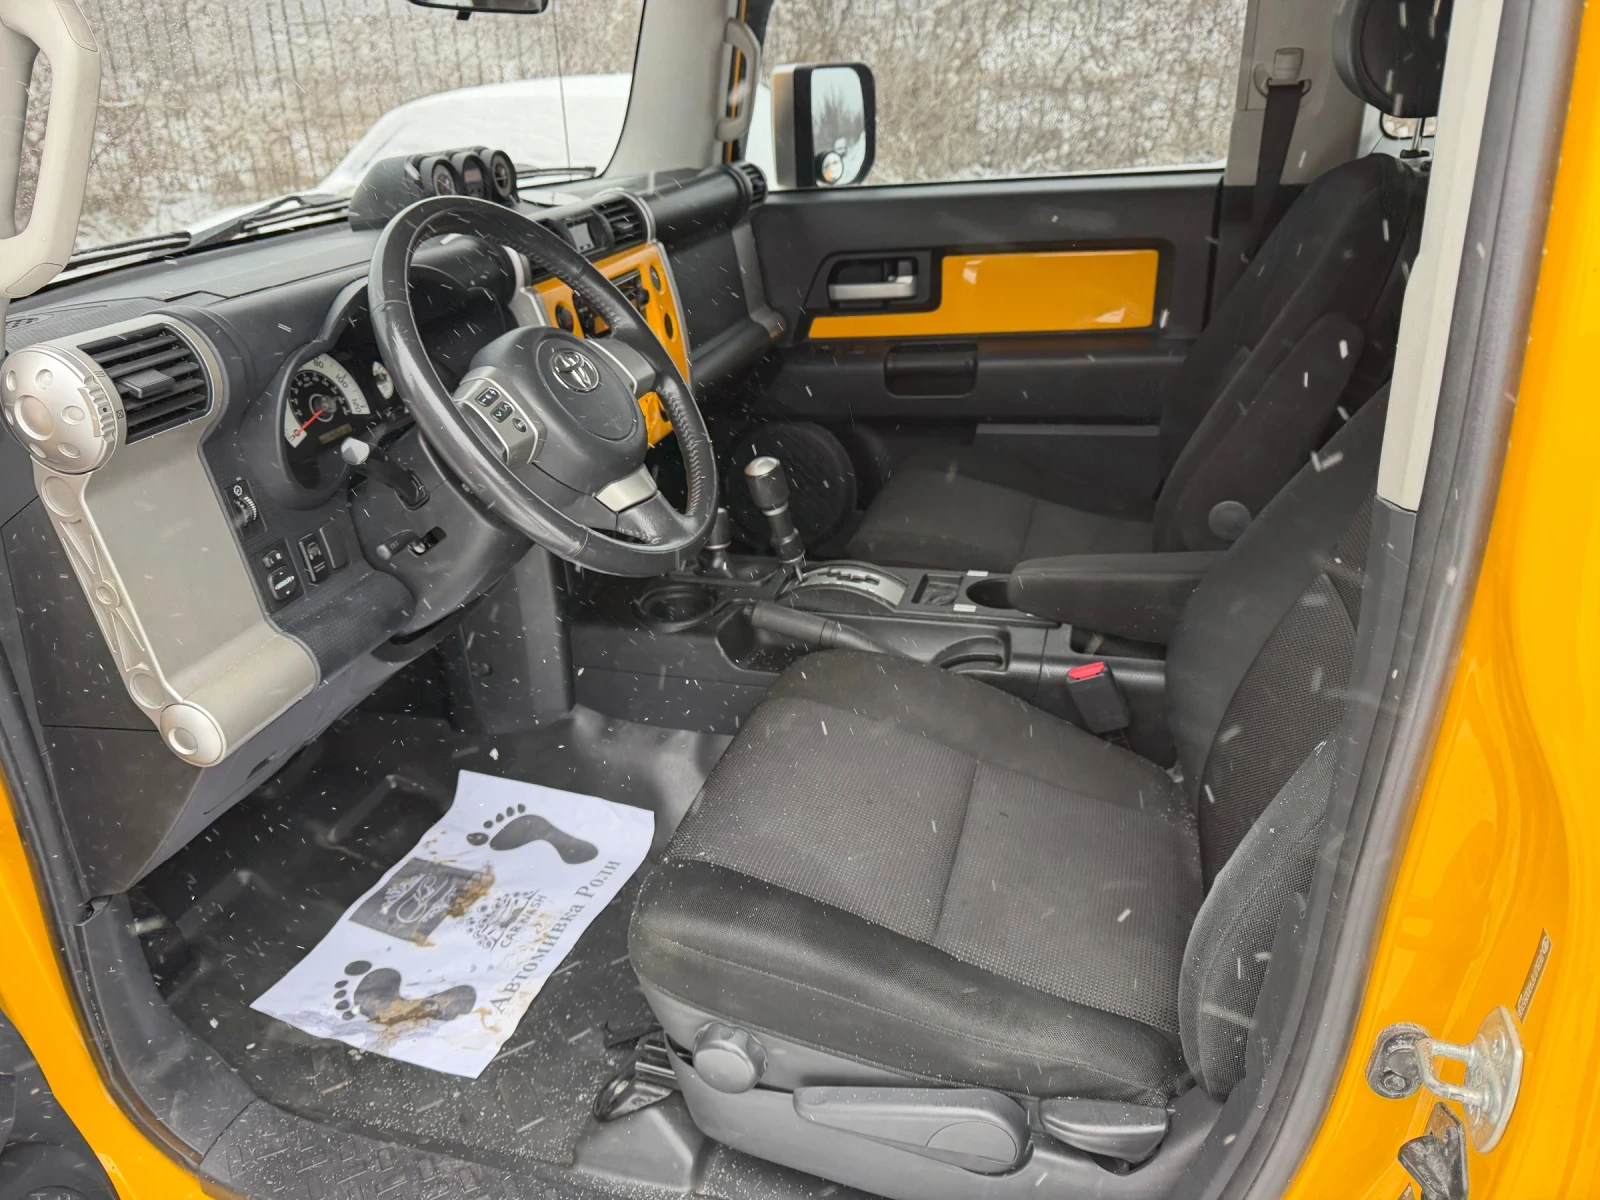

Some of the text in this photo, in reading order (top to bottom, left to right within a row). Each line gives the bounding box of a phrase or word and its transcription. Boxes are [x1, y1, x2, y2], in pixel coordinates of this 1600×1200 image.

[335, 374, 349, 389] 100
[575, 860, 622, 899] Роли
[500, 894, 547, 949] CAR WASH
